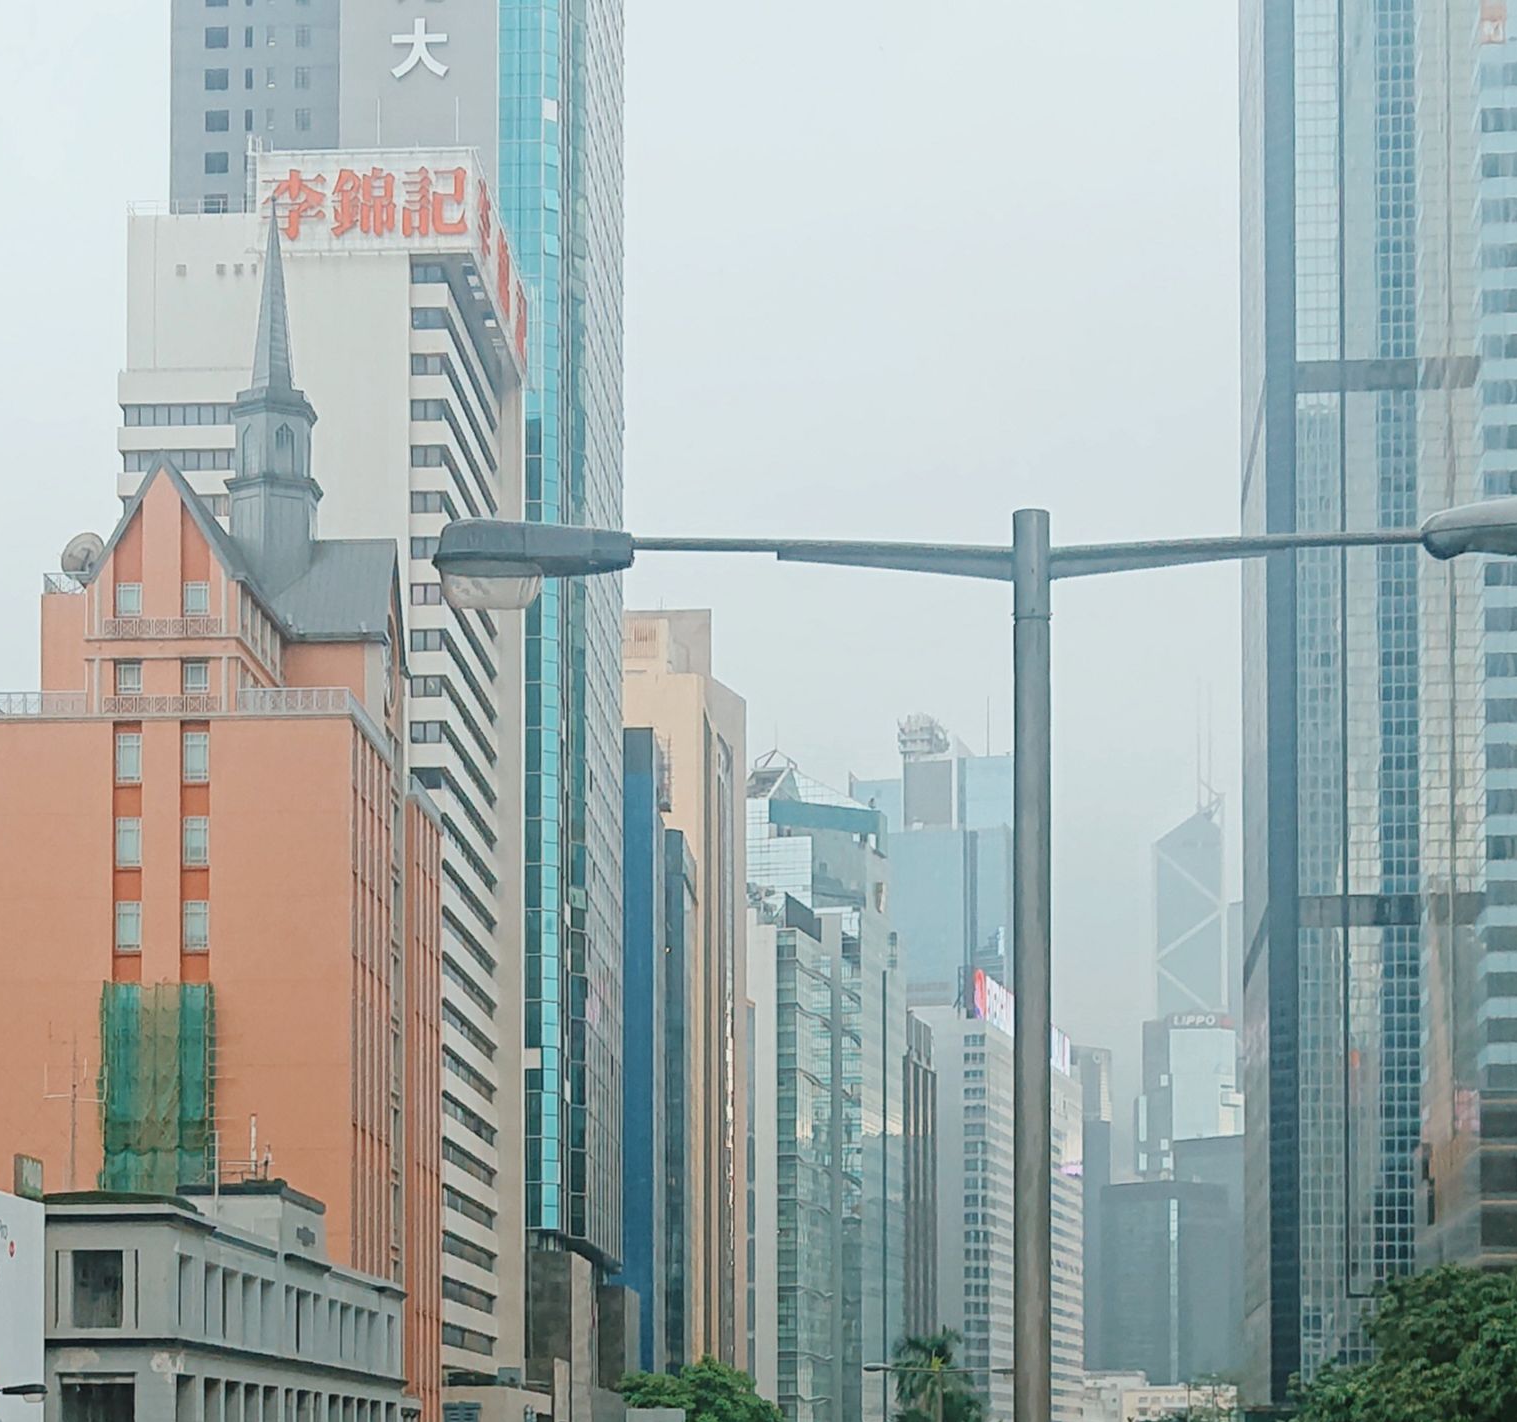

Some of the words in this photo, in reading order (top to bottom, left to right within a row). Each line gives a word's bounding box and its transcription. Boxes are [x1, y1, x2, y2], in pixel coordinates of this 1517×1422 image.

[391, 17, 450, 79] 大
[261, 166, 468, 241] 李錦記
[1173, 1014, 1216, 1026] LIPPO
